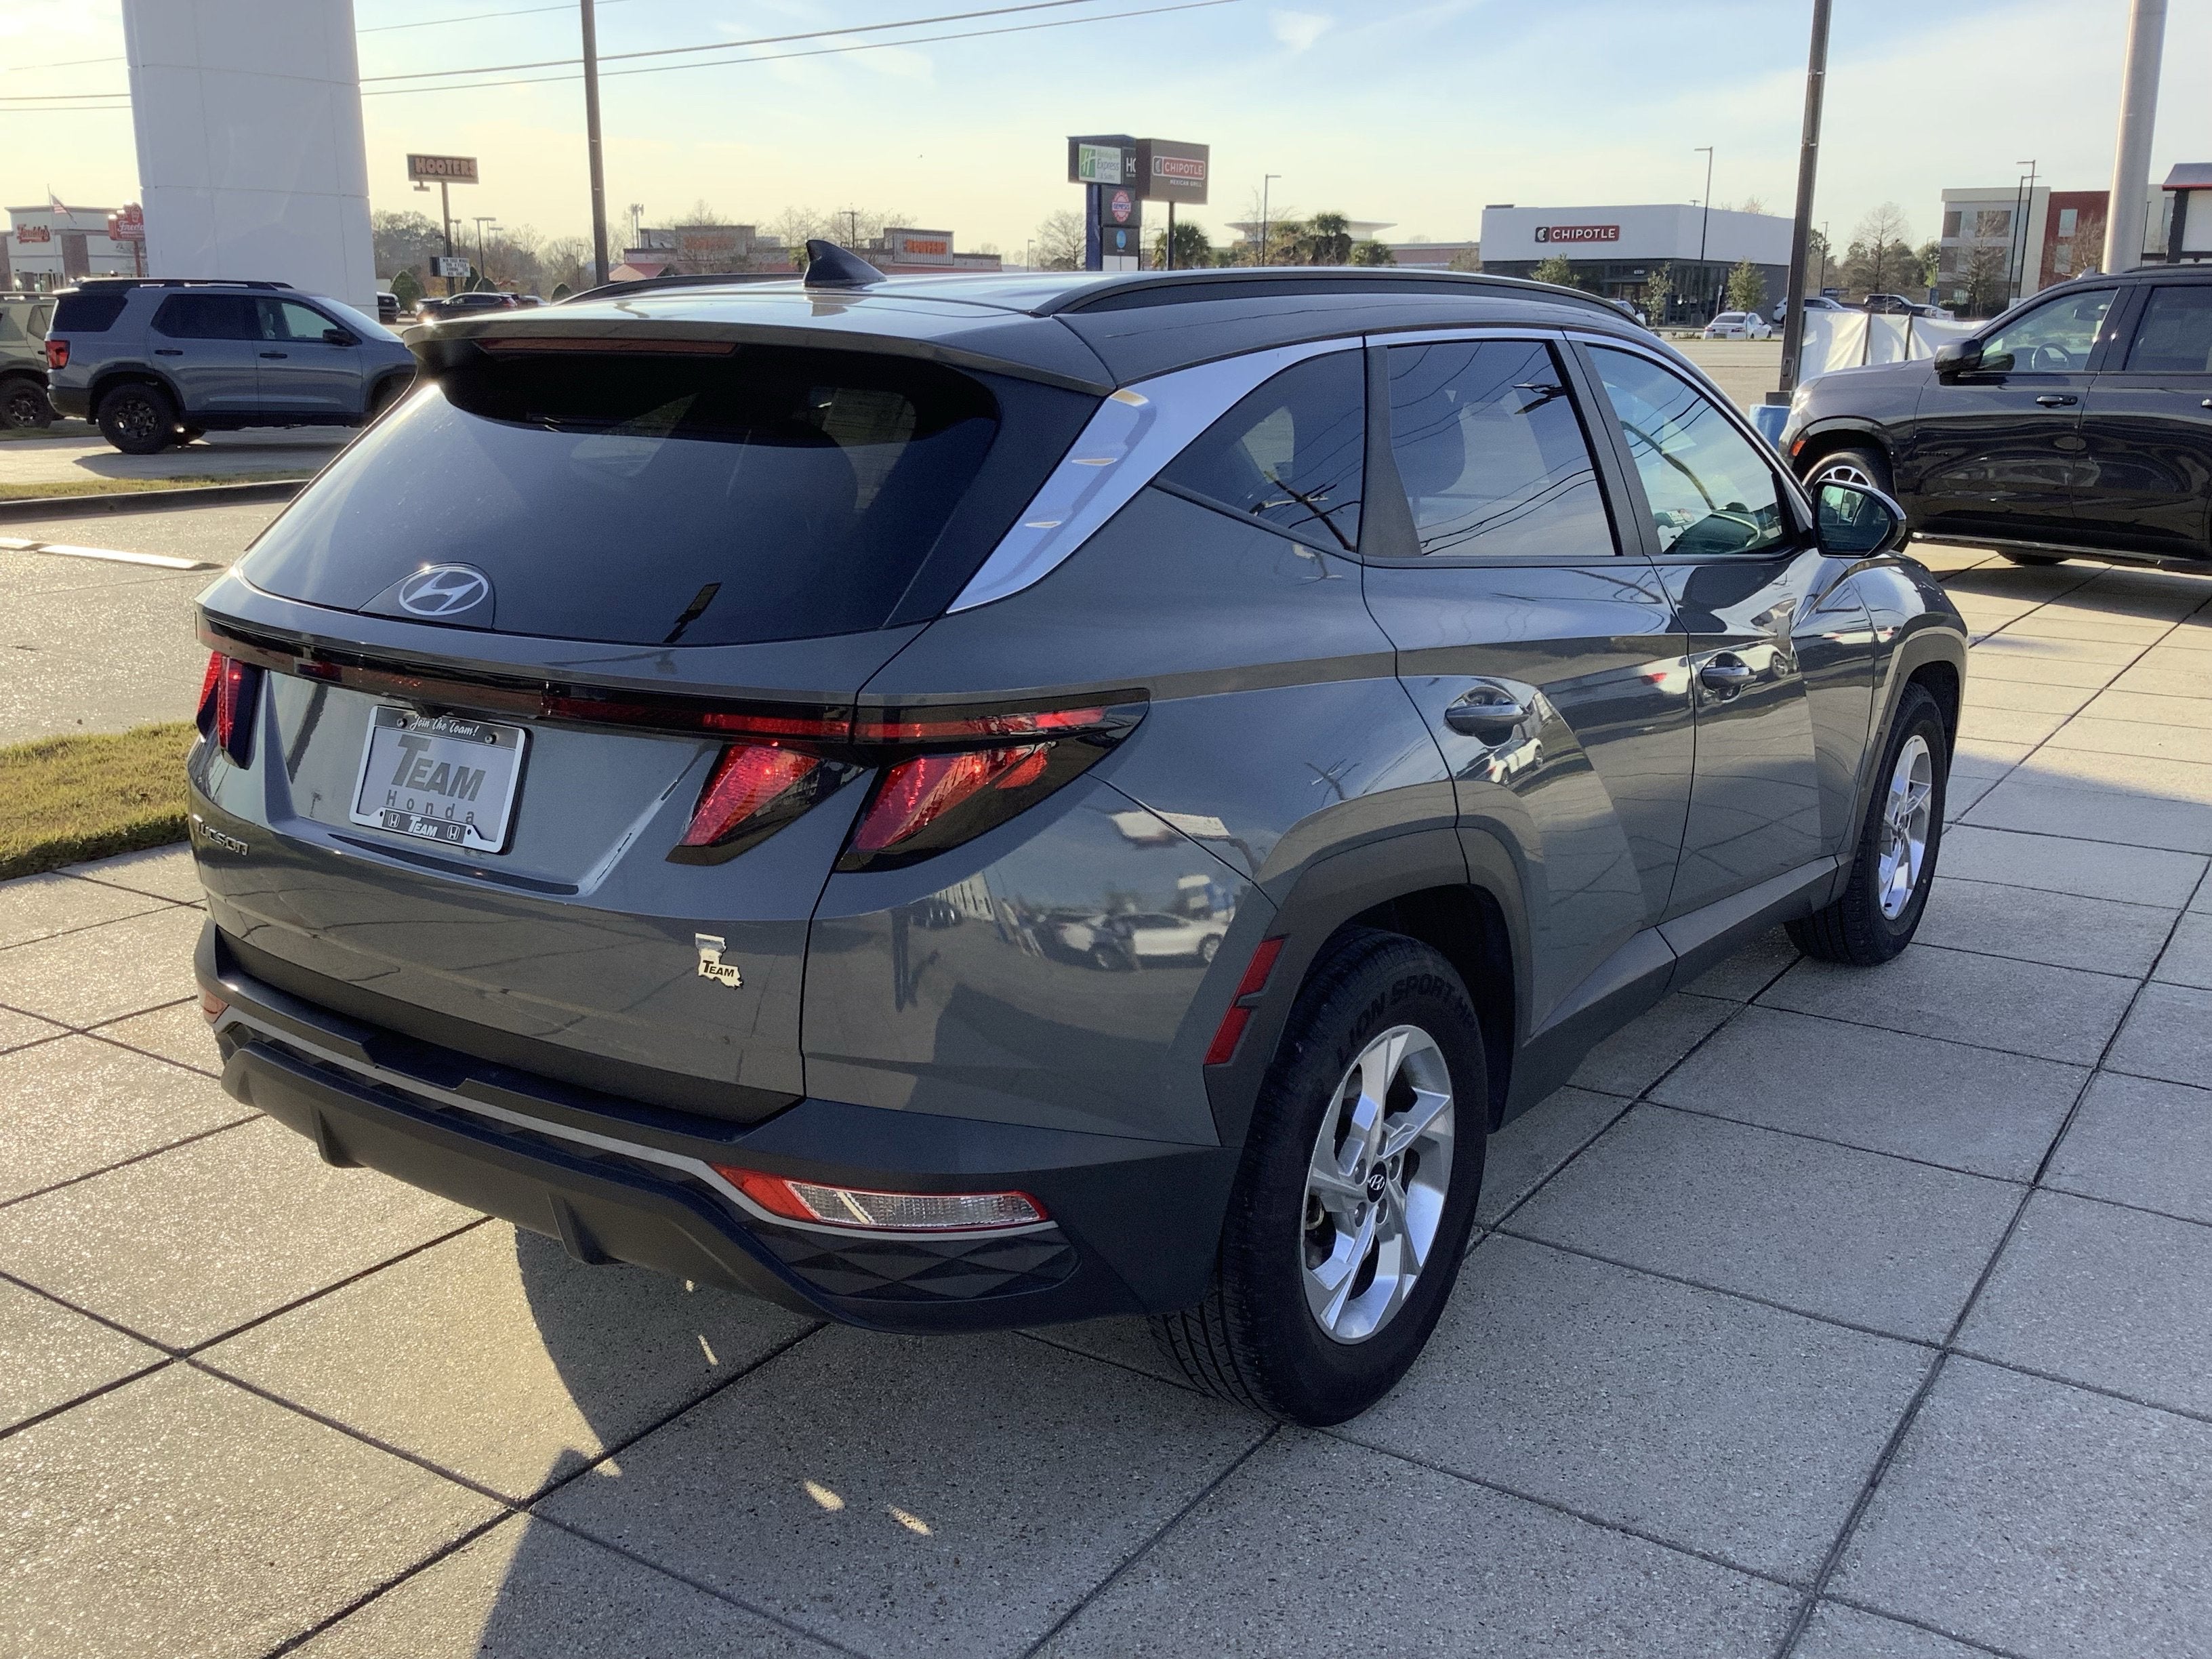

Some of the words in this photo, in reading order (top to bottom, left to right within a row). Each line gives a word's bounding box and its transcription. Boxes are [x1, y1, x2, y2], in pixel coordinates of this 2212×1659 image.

[415, 157, 475, 177] HOOTERS
[1097, 158, 1120, 171] Express
[1164, 162, 1204, 176] CHIPOTLE
[1553, 228, 1616, 239] CHIPOTLE
[409, 714, 430, 731] Join
[449, 719, 480, 737] Team!
[391, 734, 487, 802] TEAM
[386, 789, 475, 825] Honda
[408, 815, 438, 837] TEAM
[703, 960, 735, 977] TEAM
[1391, 973, 1456, 1006] SPORT
